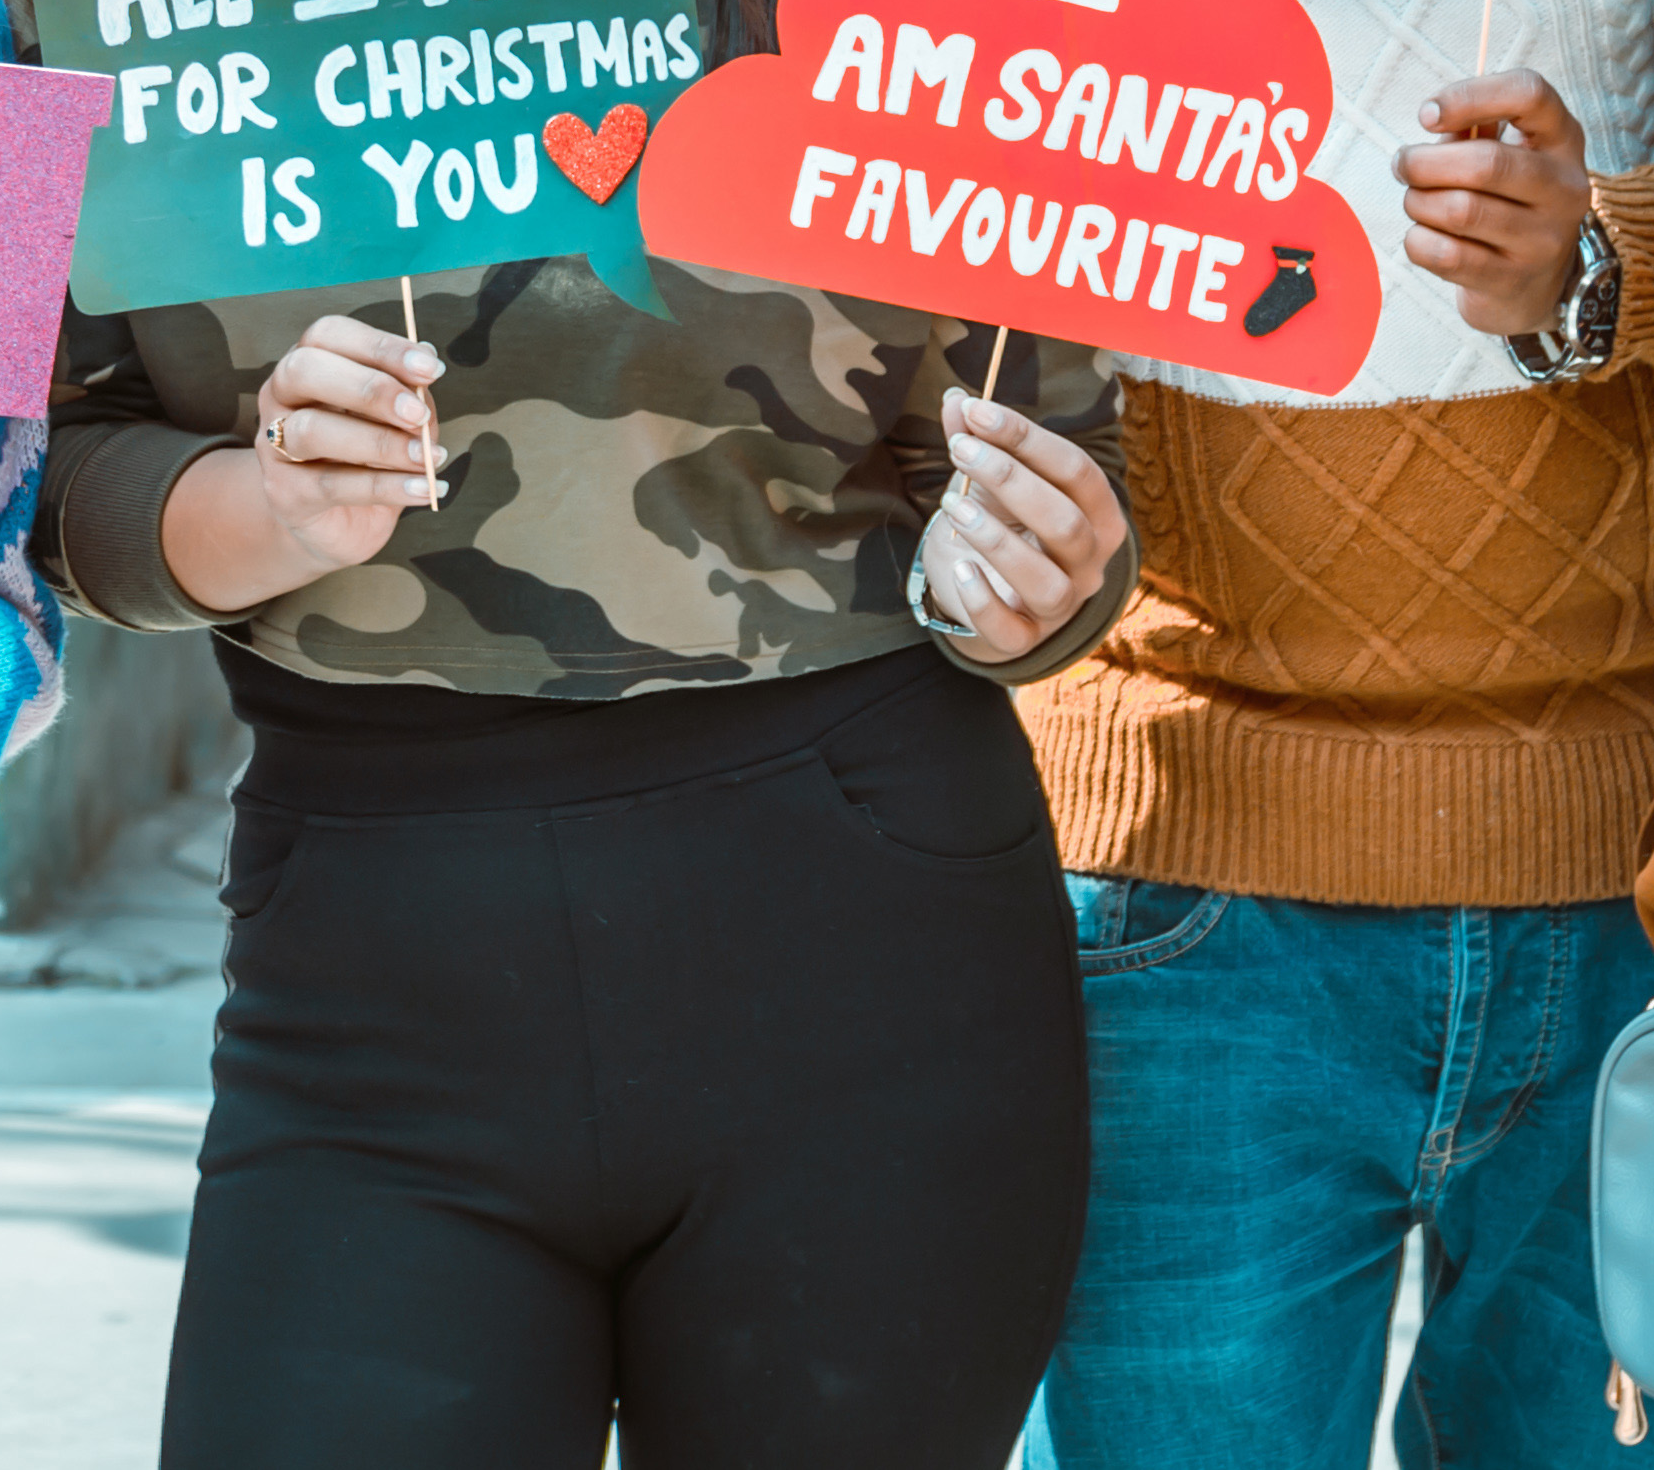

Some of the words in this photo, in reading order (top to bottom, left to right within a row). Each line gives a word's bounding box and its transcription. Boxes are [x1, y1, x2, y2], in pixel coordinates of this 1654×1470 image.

[119, 51, 278, 145] FOR
[314, 13, 700, 128] CHRISTMAS
[811, 13, 977, 128] AM
[983, 48, 1309, 202] SANTA'S
[241, 155, 322, 247] IS
[361, 132, 538, 229] YOU
[789, 145, 1246, 323] FAVOURITE
